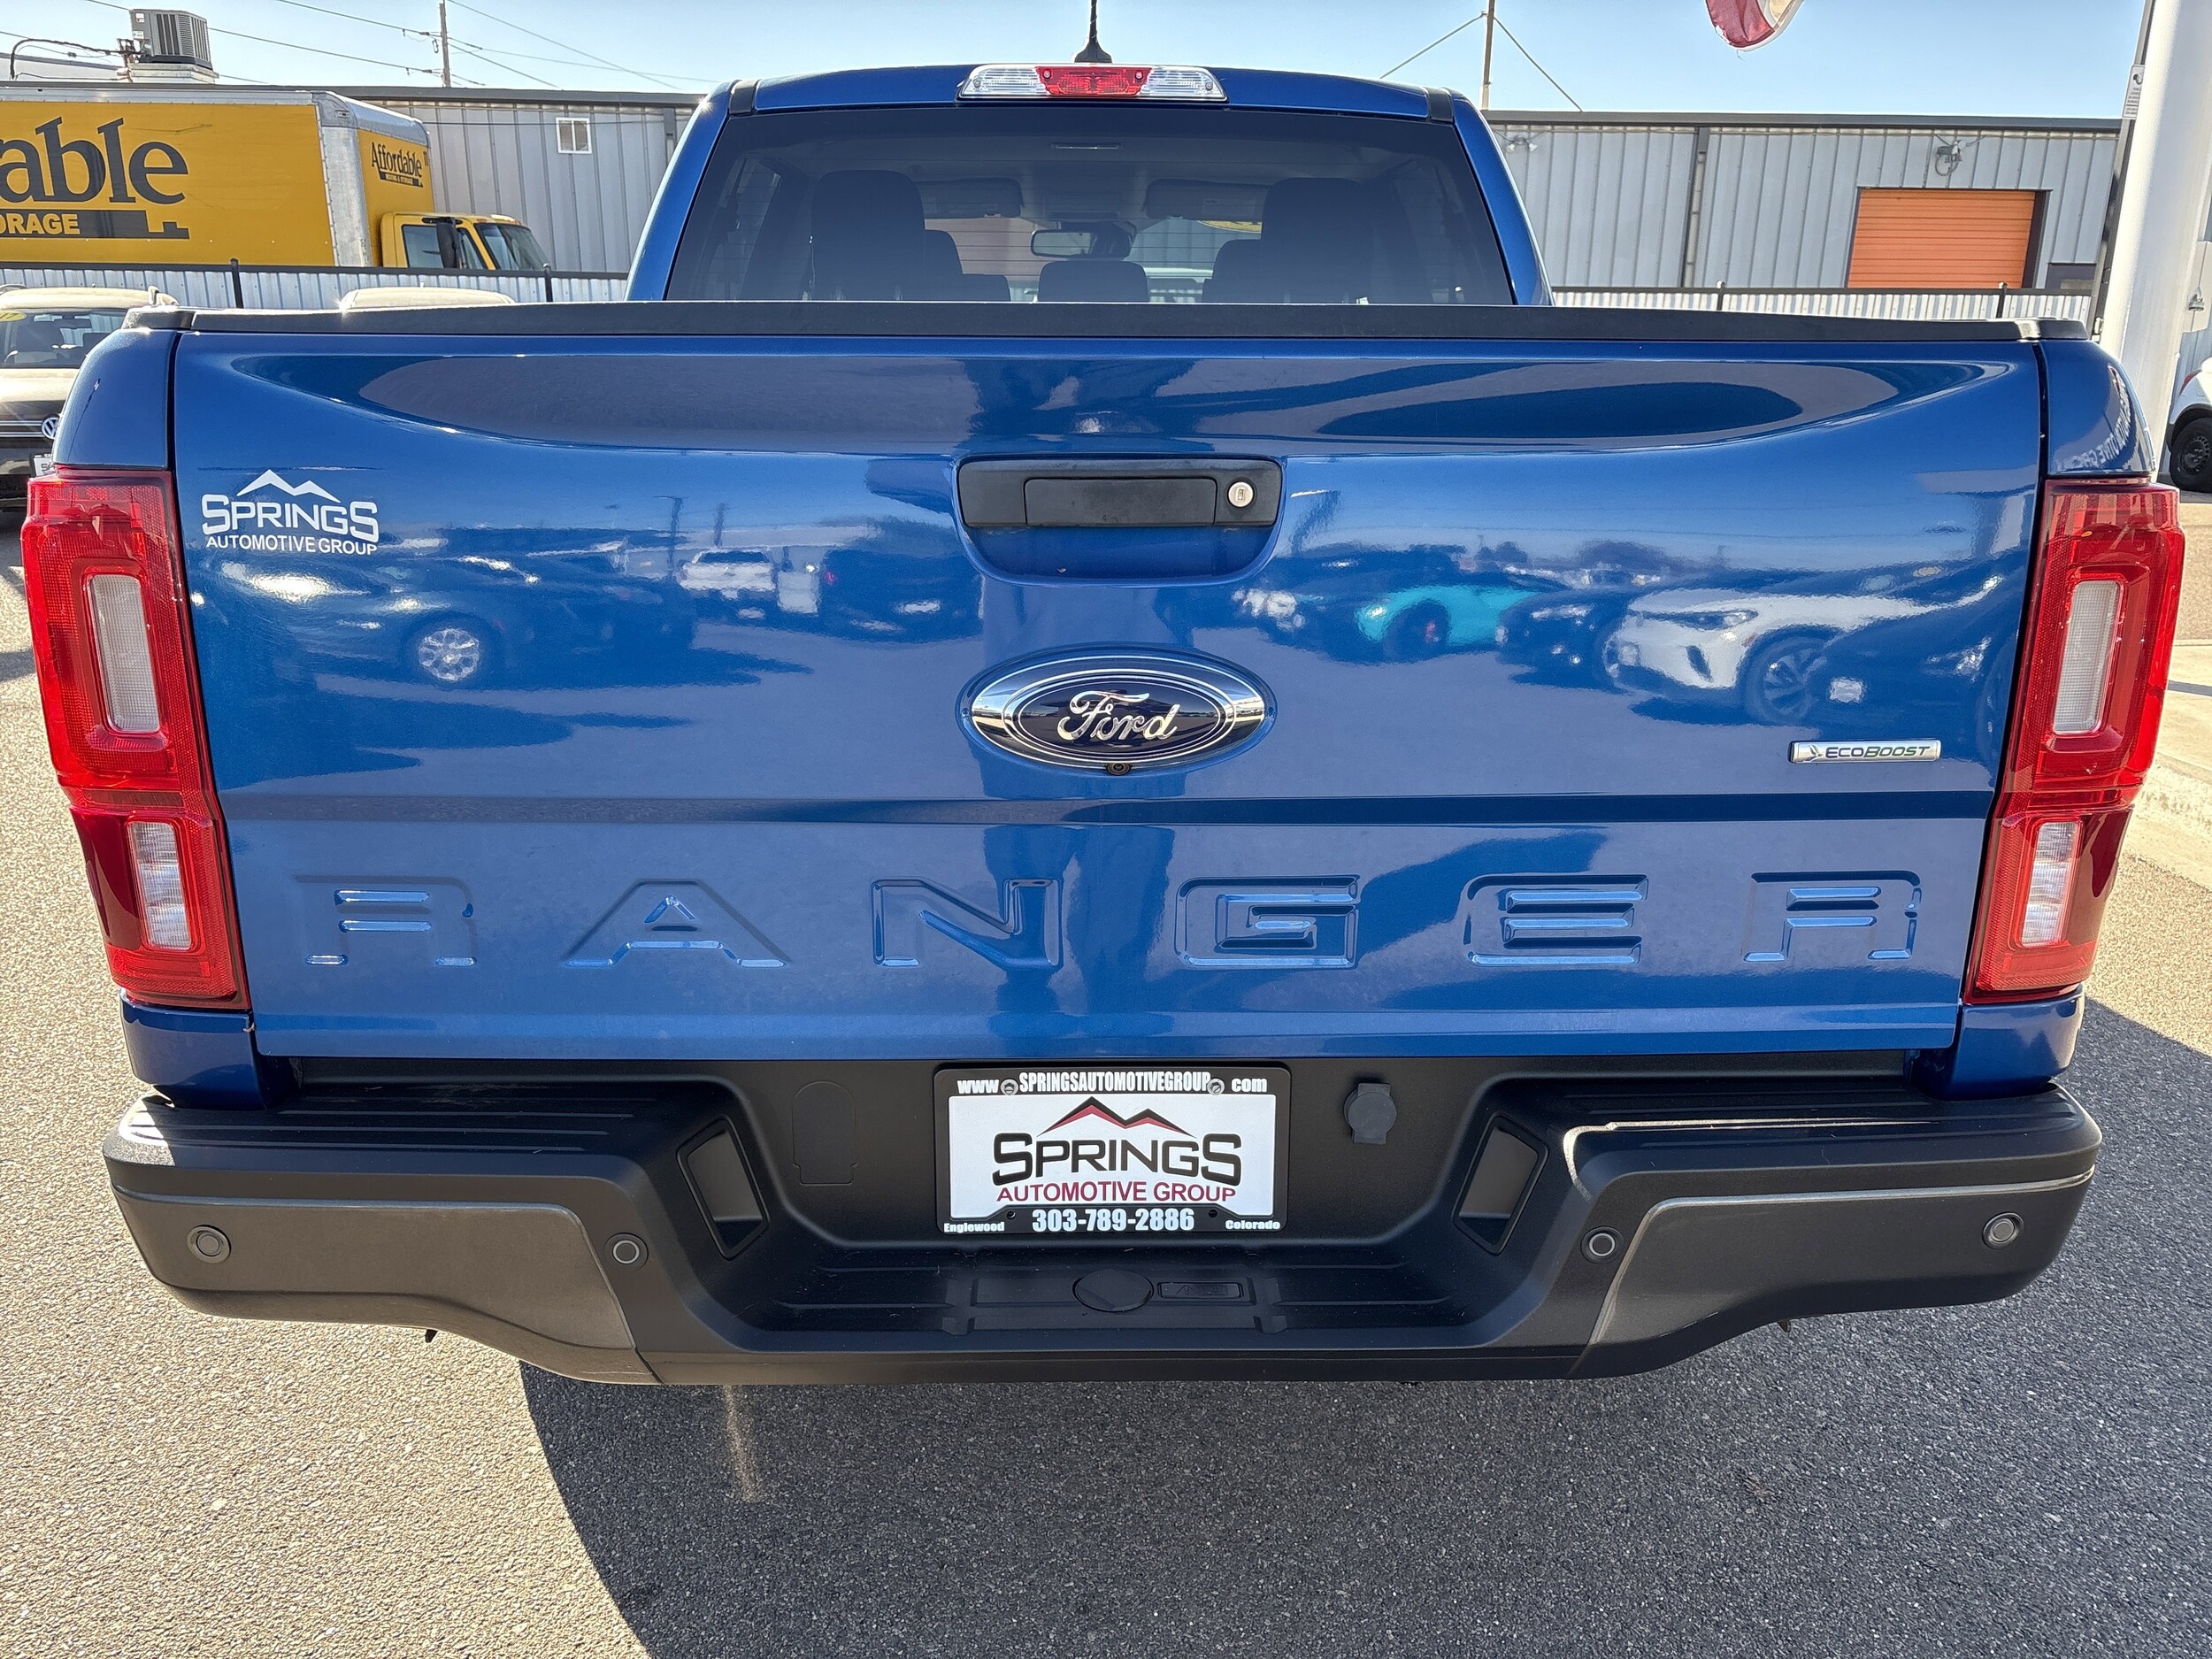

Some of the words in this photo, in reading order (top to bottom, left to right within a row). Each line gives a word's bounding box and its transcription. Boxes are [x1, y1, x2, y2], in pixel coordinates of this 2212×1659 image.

[372, 142, 422, 178] Affordable
[201, 493, 379, 543] SPRINGS
[205, 534, 316, 553] AUTOMOTIVE
[318, 535, 378, 556] GROUP
[1056, 690, 1181, 741] Ford
[1825, 746, 1932, 758] ECOBOOST
[293, 869, 1922, 972] RANGER
[956, 1079, 1000, 1094] www
[1019, 1071, 1211, 1093] SPRINGSAUTOMOTIVEGROUP
[1231, 1077, 1268, 1093] com
[992, 1132, 1242, 1187] SPRINGS
[996, 1180, 1148, 1202] AUTOMOTIVE
[1153, 1181, 1237, 1202] GROUP
[943, 1221, 1005, 1233] Englewood
[1225, 1219, 1281, 1231] Colorado
[1032, 1208, 1195, 1233] 303-789-2886
